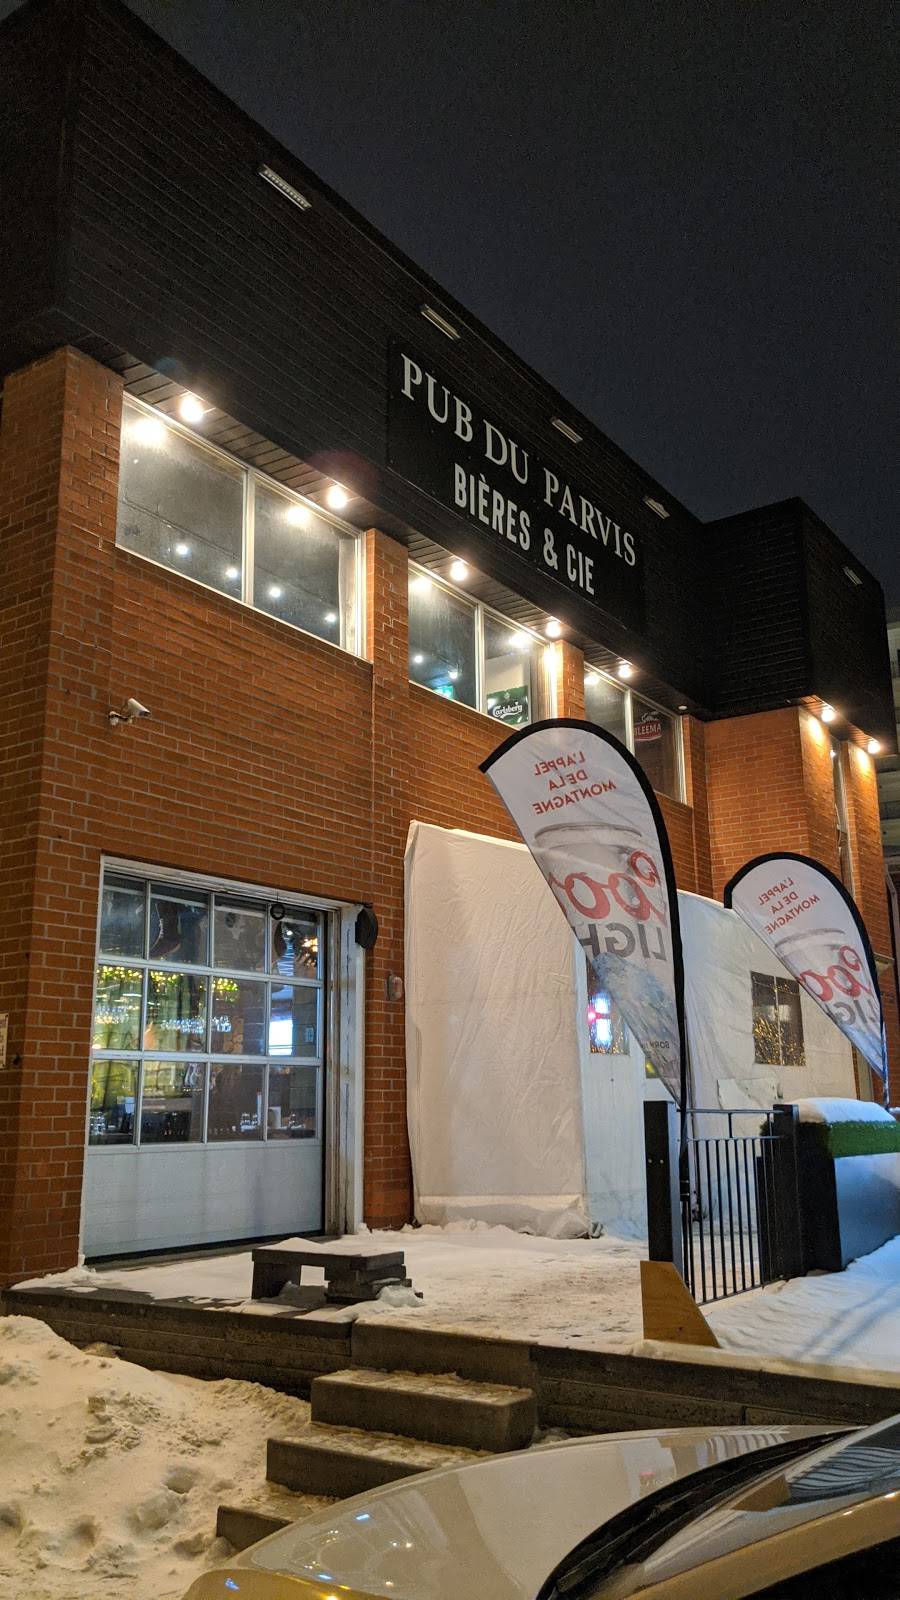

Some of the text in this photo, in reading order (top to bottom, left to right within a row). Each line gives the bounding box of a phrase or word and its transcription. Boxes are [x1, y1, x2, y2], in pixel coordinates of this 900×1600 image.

[400, 353, 636, 567] PUB DU PARVIS
[454, 462, 595, 596] BIÈRES & CIE
[492, 703, 523, 719] Carlsberg
